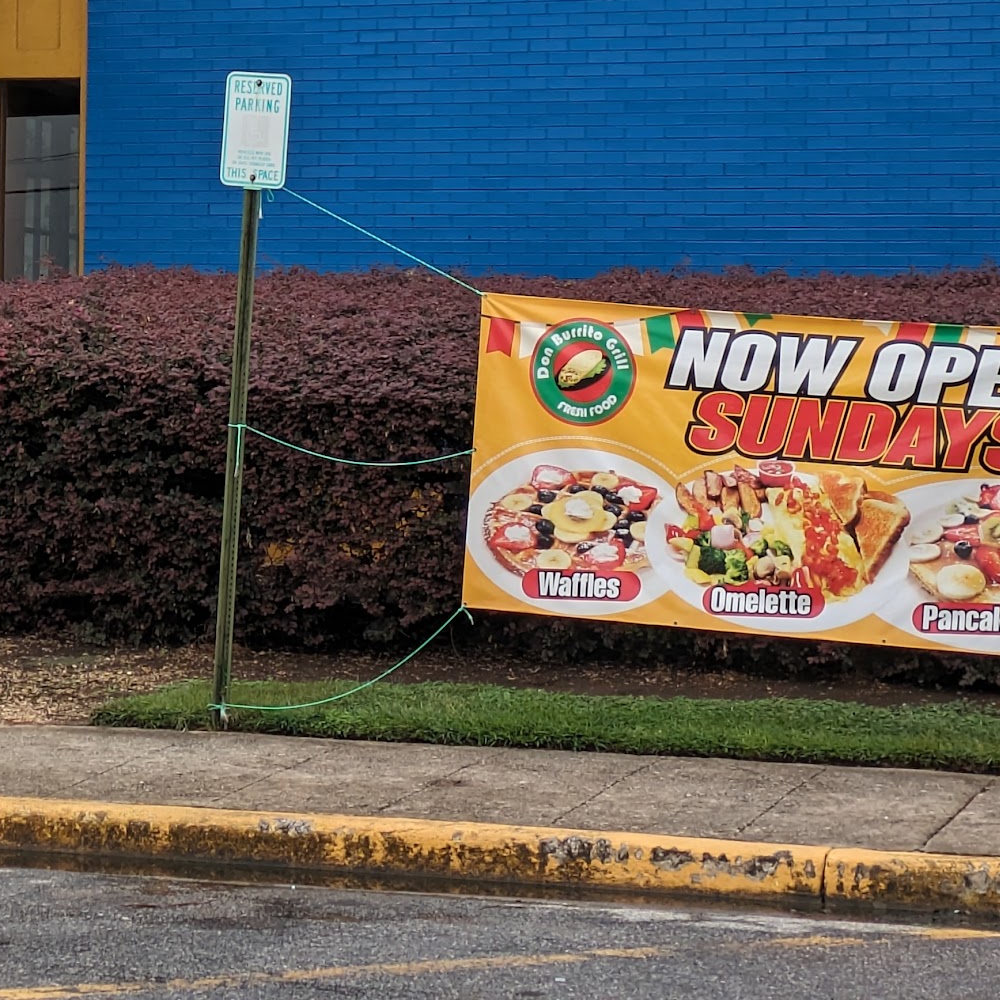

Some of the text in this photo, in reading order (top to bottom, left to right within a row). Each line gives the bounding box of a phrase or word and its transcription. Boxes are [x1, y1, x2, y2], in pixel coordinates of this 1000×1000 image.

[234, 79, 283, 96] RESERVED
[235, 97, 280, 113] PARKING
[226, 167, 279, 181] THIS SPACE
[536, 324, 630, 379] Don Burrito Grill
[667, 329, 861, 397] NOW
[557, 395, 618, 418] FRESH FOOD
[537, 570, 621, 599] Waffles
[710, 586, 811, 615] Omelette
